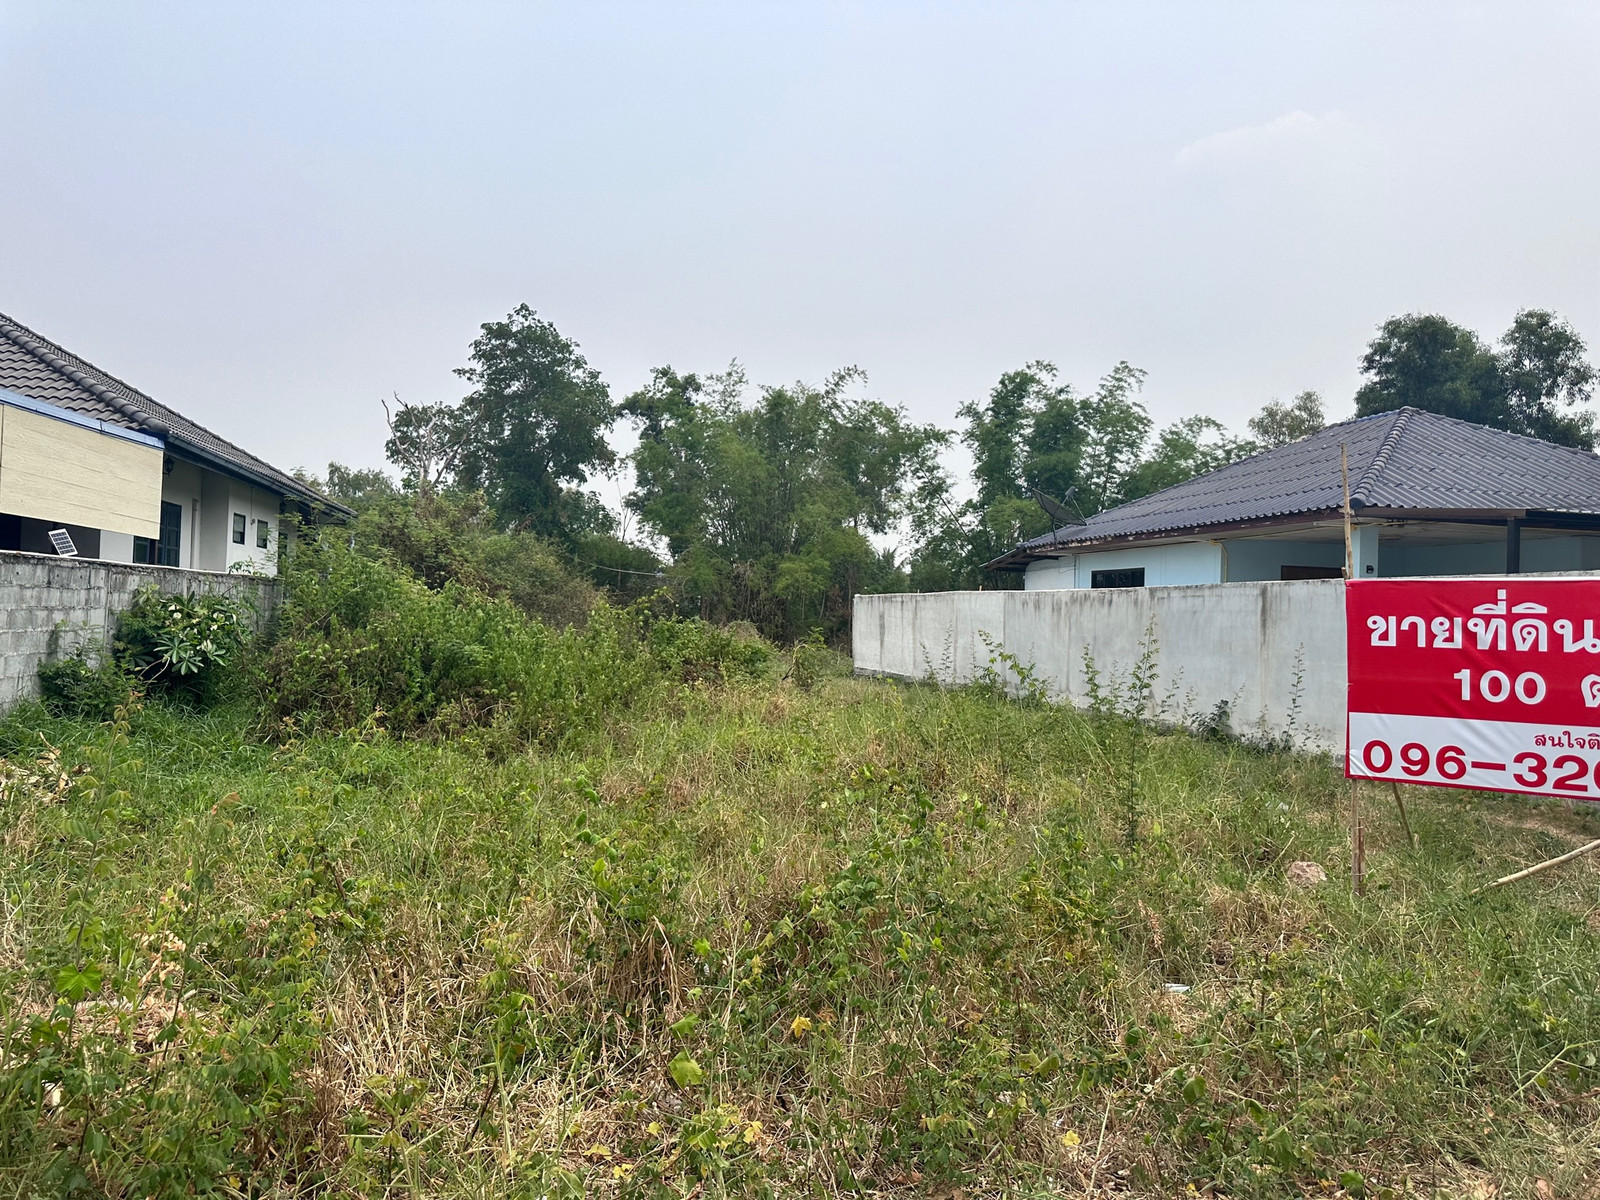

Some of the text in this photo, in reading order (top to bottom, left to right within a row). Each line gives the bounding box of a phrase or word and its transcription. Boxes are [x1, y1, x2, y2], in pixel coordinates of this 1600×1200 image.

[1366, 588, 1600, 654] ขายที่ดิน
[1453, 668, 1547, 705] 100
[1362, 739, 1600, 792] 096-32
